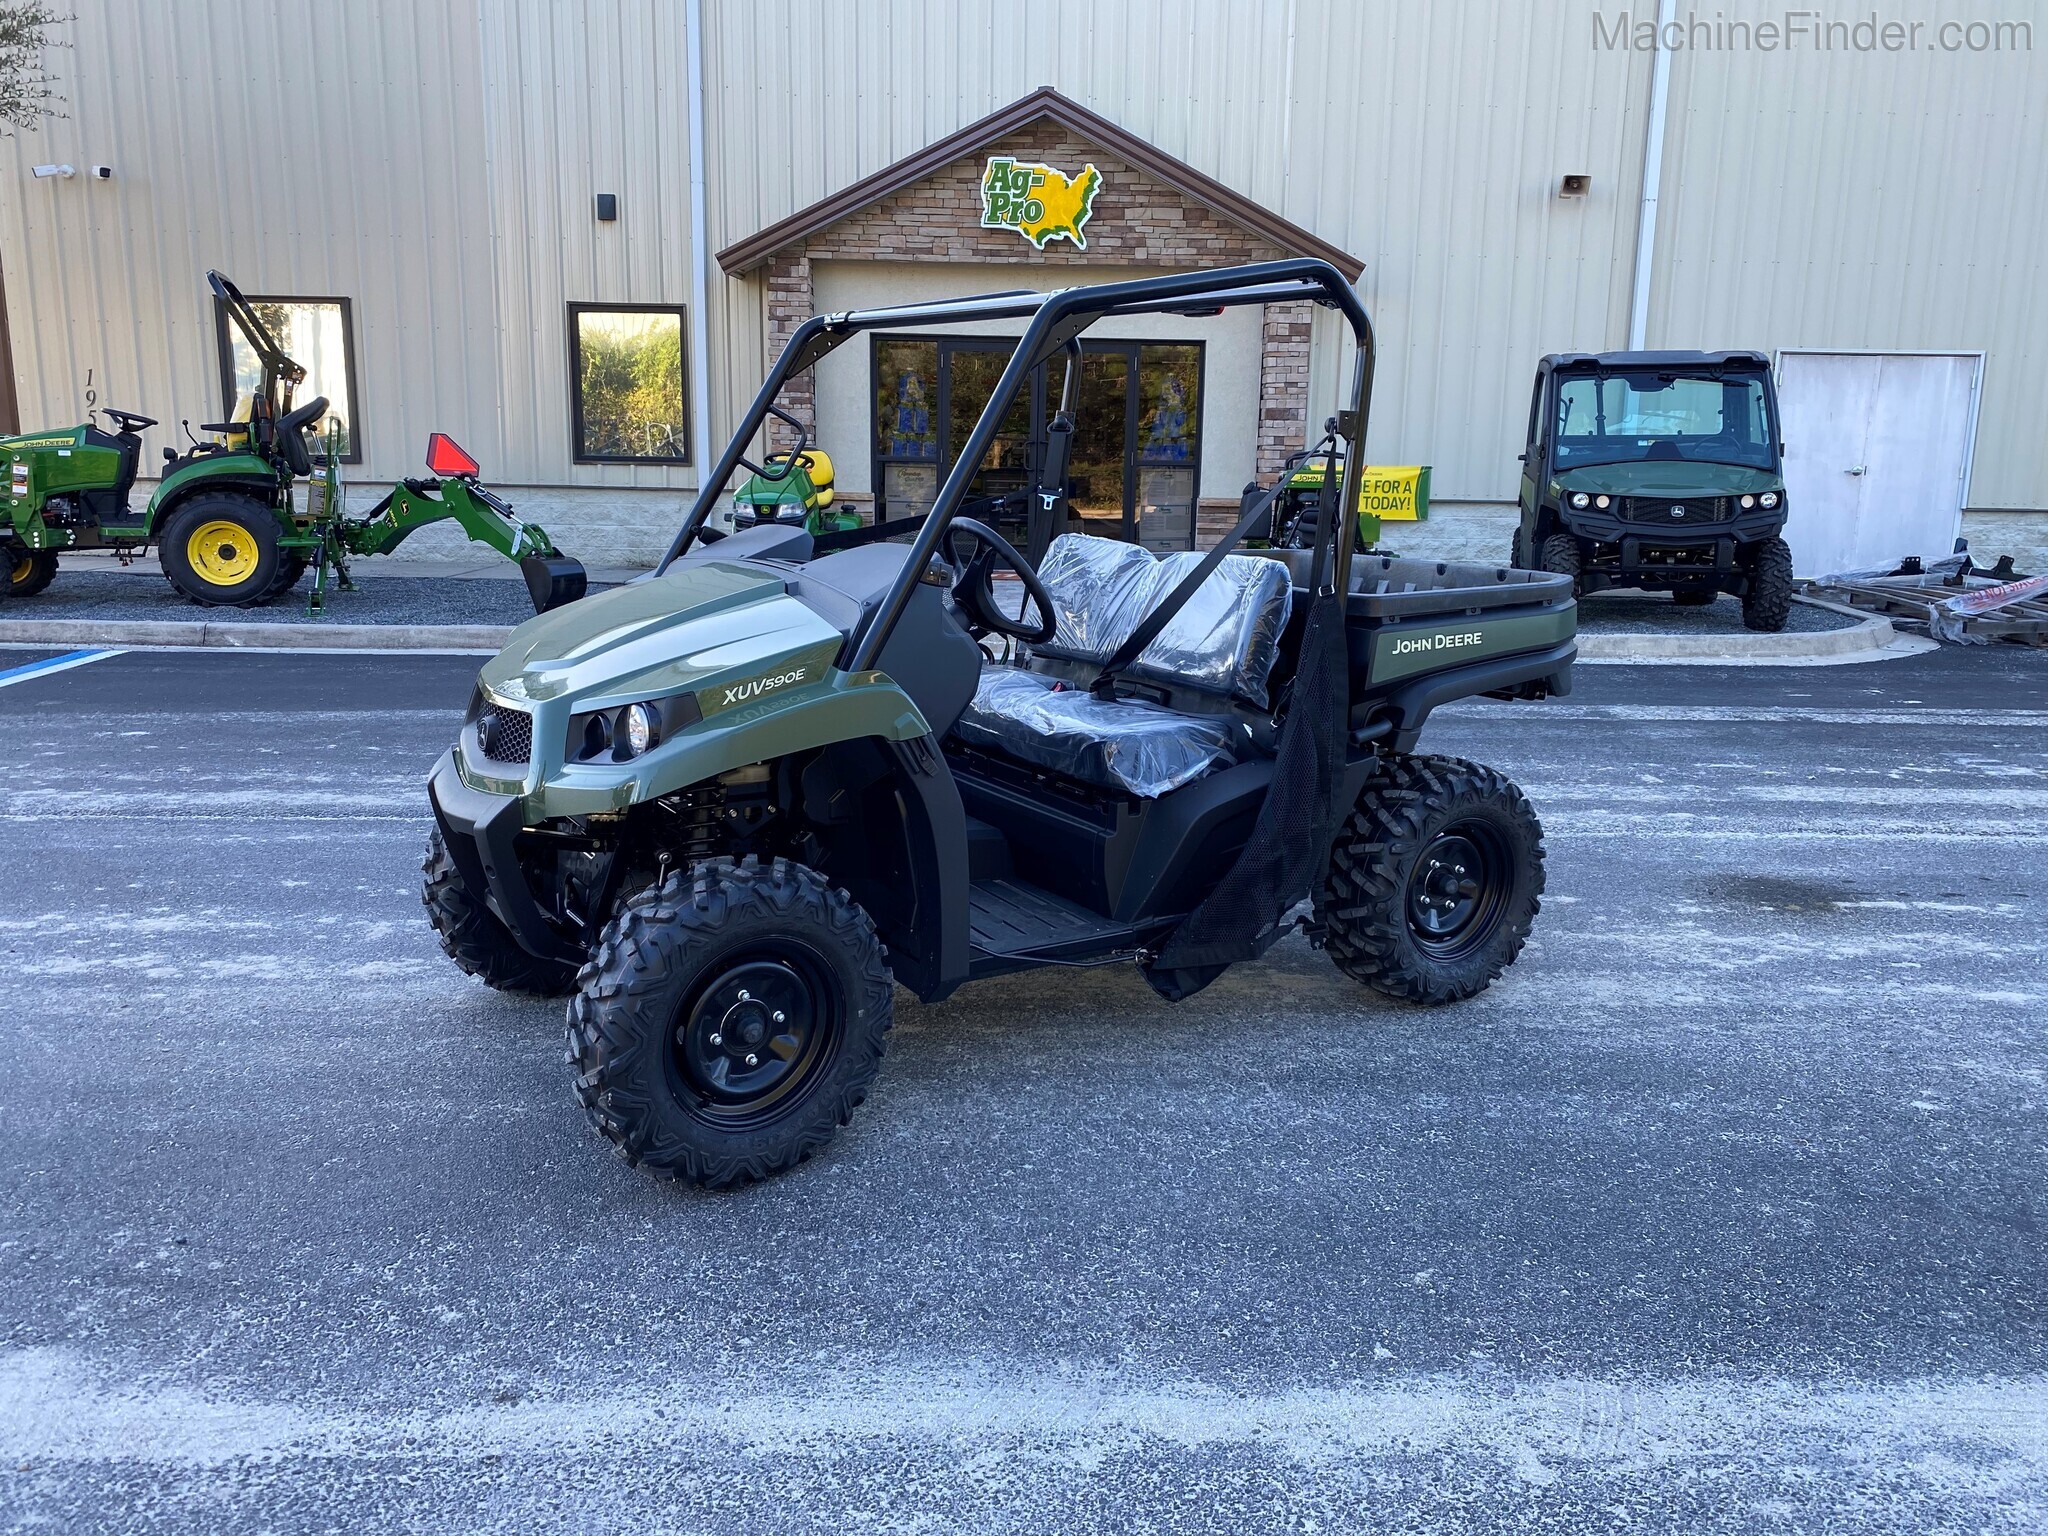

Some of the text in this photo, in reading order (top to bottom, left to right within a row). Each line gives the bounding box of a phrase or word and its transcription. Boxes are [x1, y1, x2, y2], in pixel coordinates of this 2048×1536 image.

[986, 161, 1044, 198] Ag-
[986, 192, 1043, 223] Pro
[1374, 480, 1401, 494] FOR
[1402, 480, 1412, 494] A
[1362, 496, 1411, 511] TODAY!
[1392, 632, 1482, 655] JOHN DEERE
[722, 668, 806, 706] XUV590E
